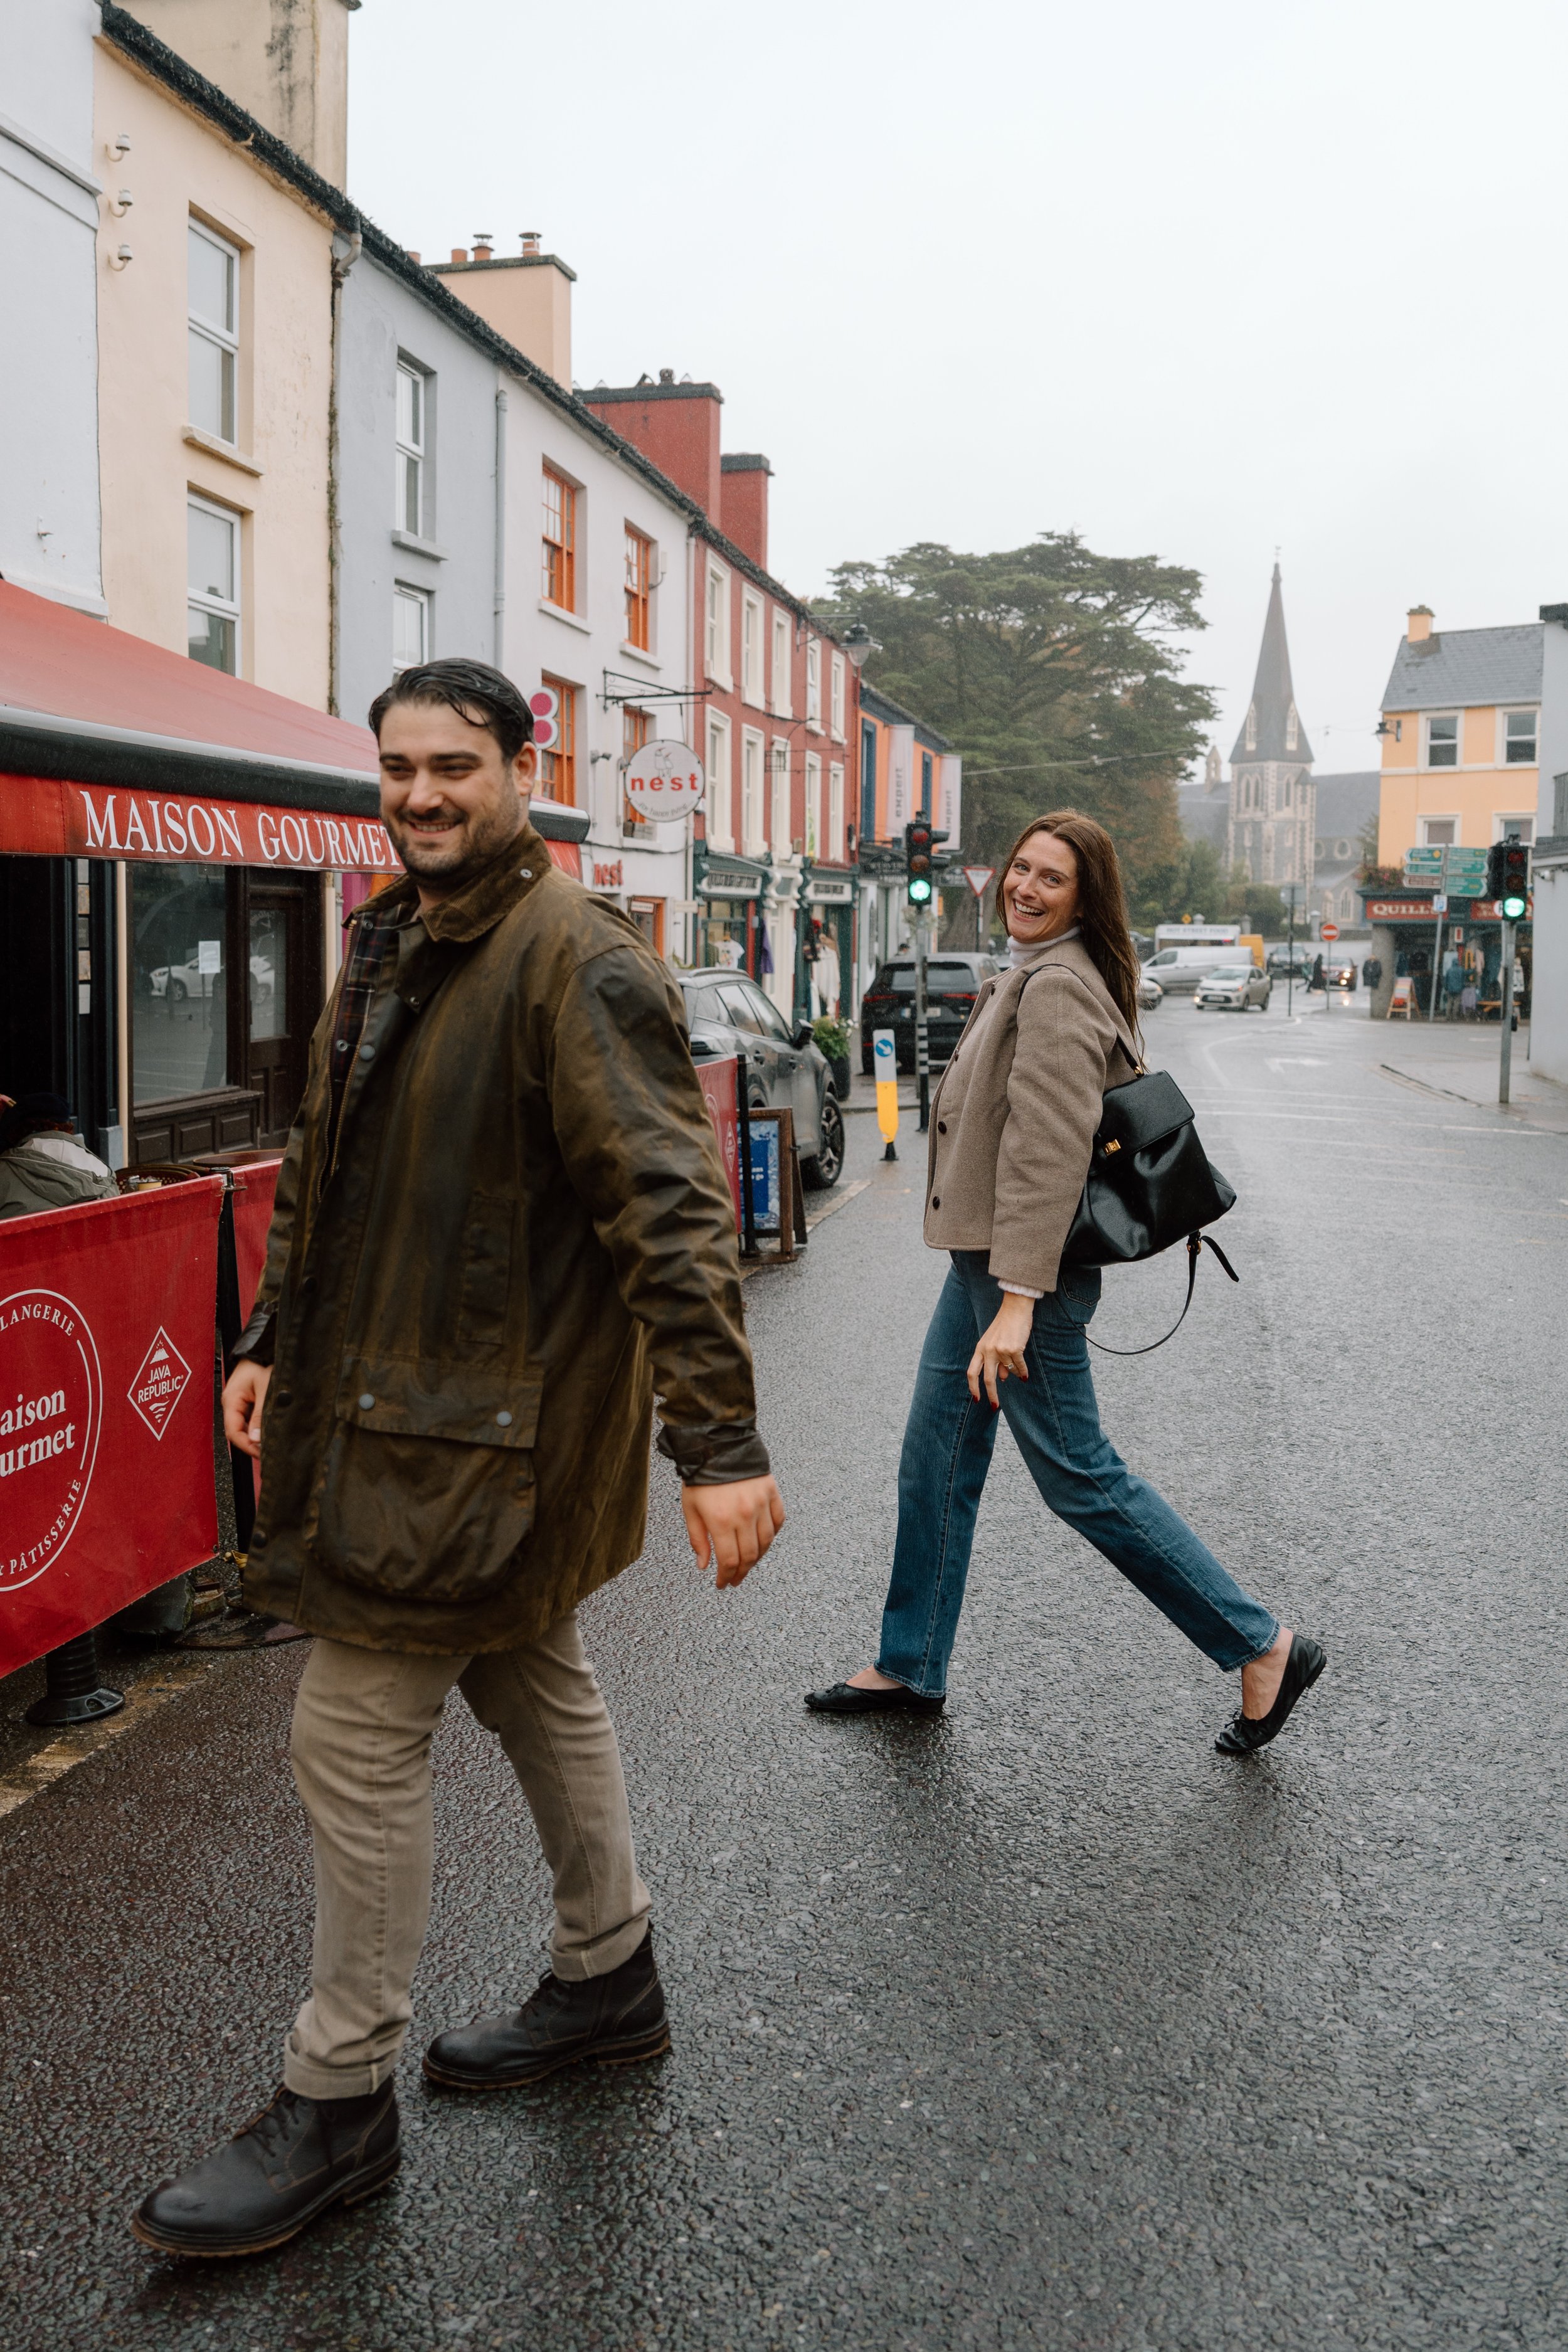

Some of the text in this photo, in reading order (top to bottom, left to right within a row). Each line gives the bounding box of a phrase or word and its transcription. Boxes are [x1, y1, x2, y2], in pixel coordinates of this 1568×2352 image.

[631, 773, 698, 791] nest
[895, 768, 903, 817] expert
[79, 790, 400, 867] MAISON GOURMET
[593, 859, 623, 886] nest
[147, 1364, 171, 1384] JAVA
[0, 1389, 66, 1436] aison
[0, 1422, 75, 1477] urmet
[9, 1479, 81, 1575] PÂTISSERIE
